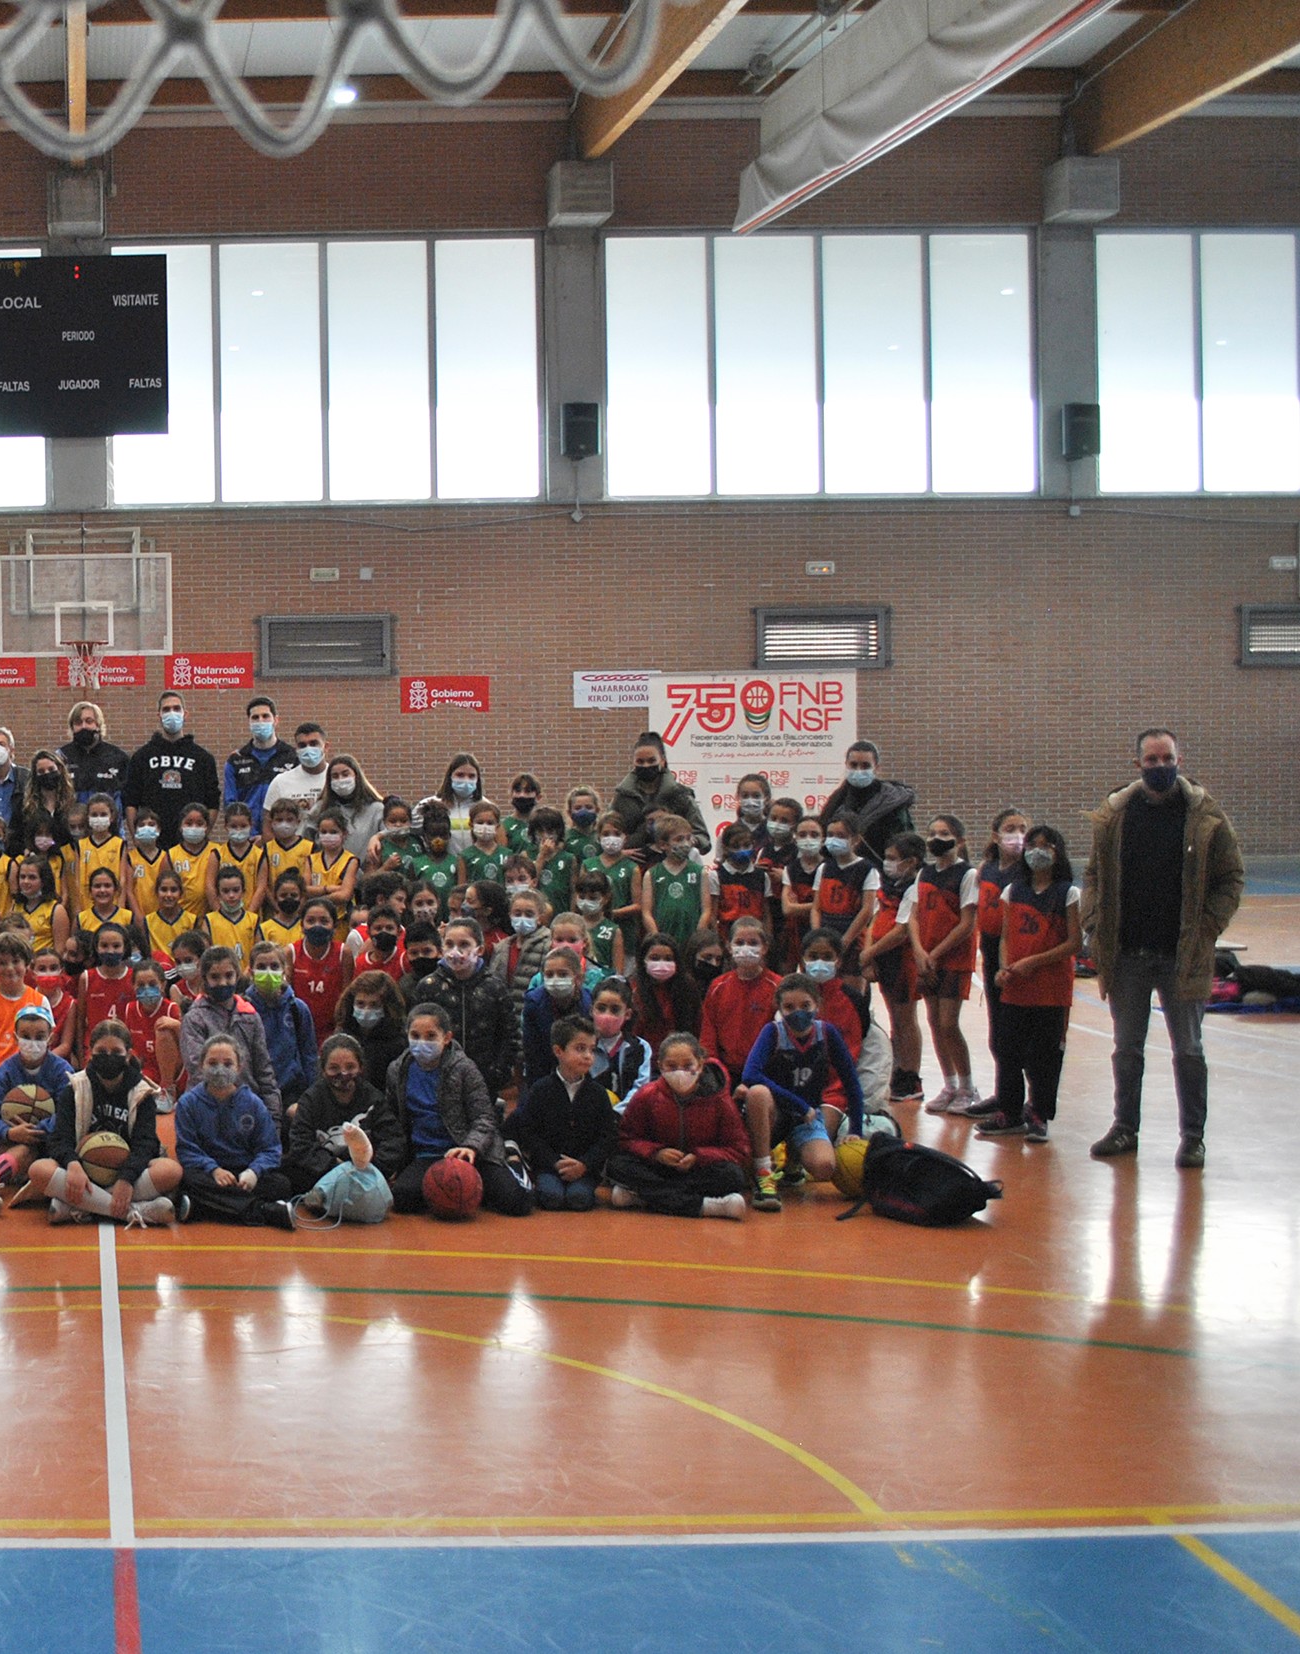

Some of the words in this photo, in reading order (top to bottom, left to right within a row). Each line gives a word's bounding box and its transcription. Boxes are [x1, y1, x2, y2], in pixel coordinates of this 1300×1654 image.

[112, 294, 159, 306] VISITANTE
[62, 330, 95, 341] PERIODO
[58, 379, 100, 390] JUGADOR
[129, 378, 162, 388] FALTAS
[194, 666, 246, 674] Nafarroako
[194, 676, 240, 684] Gobernua
[431, 689, 474, 698] Gobierno
[591, 684, 648, 692] NAFARROAKO
[779, 681, 844, 706] FNB
[661, 683, 735, 747] 75
[779, 707, 843, 732] NSF
[149, 755, 196, 771] CBVE
[618, 867, 626, 878] 5
[598, 925, 613, 940] 25
[308, 980, 325, 993] 14
[108, 1004, 117, 1018] 4
[146, 1040, 154, 1053] 5
[792, 1067, 813, 1087] 19
